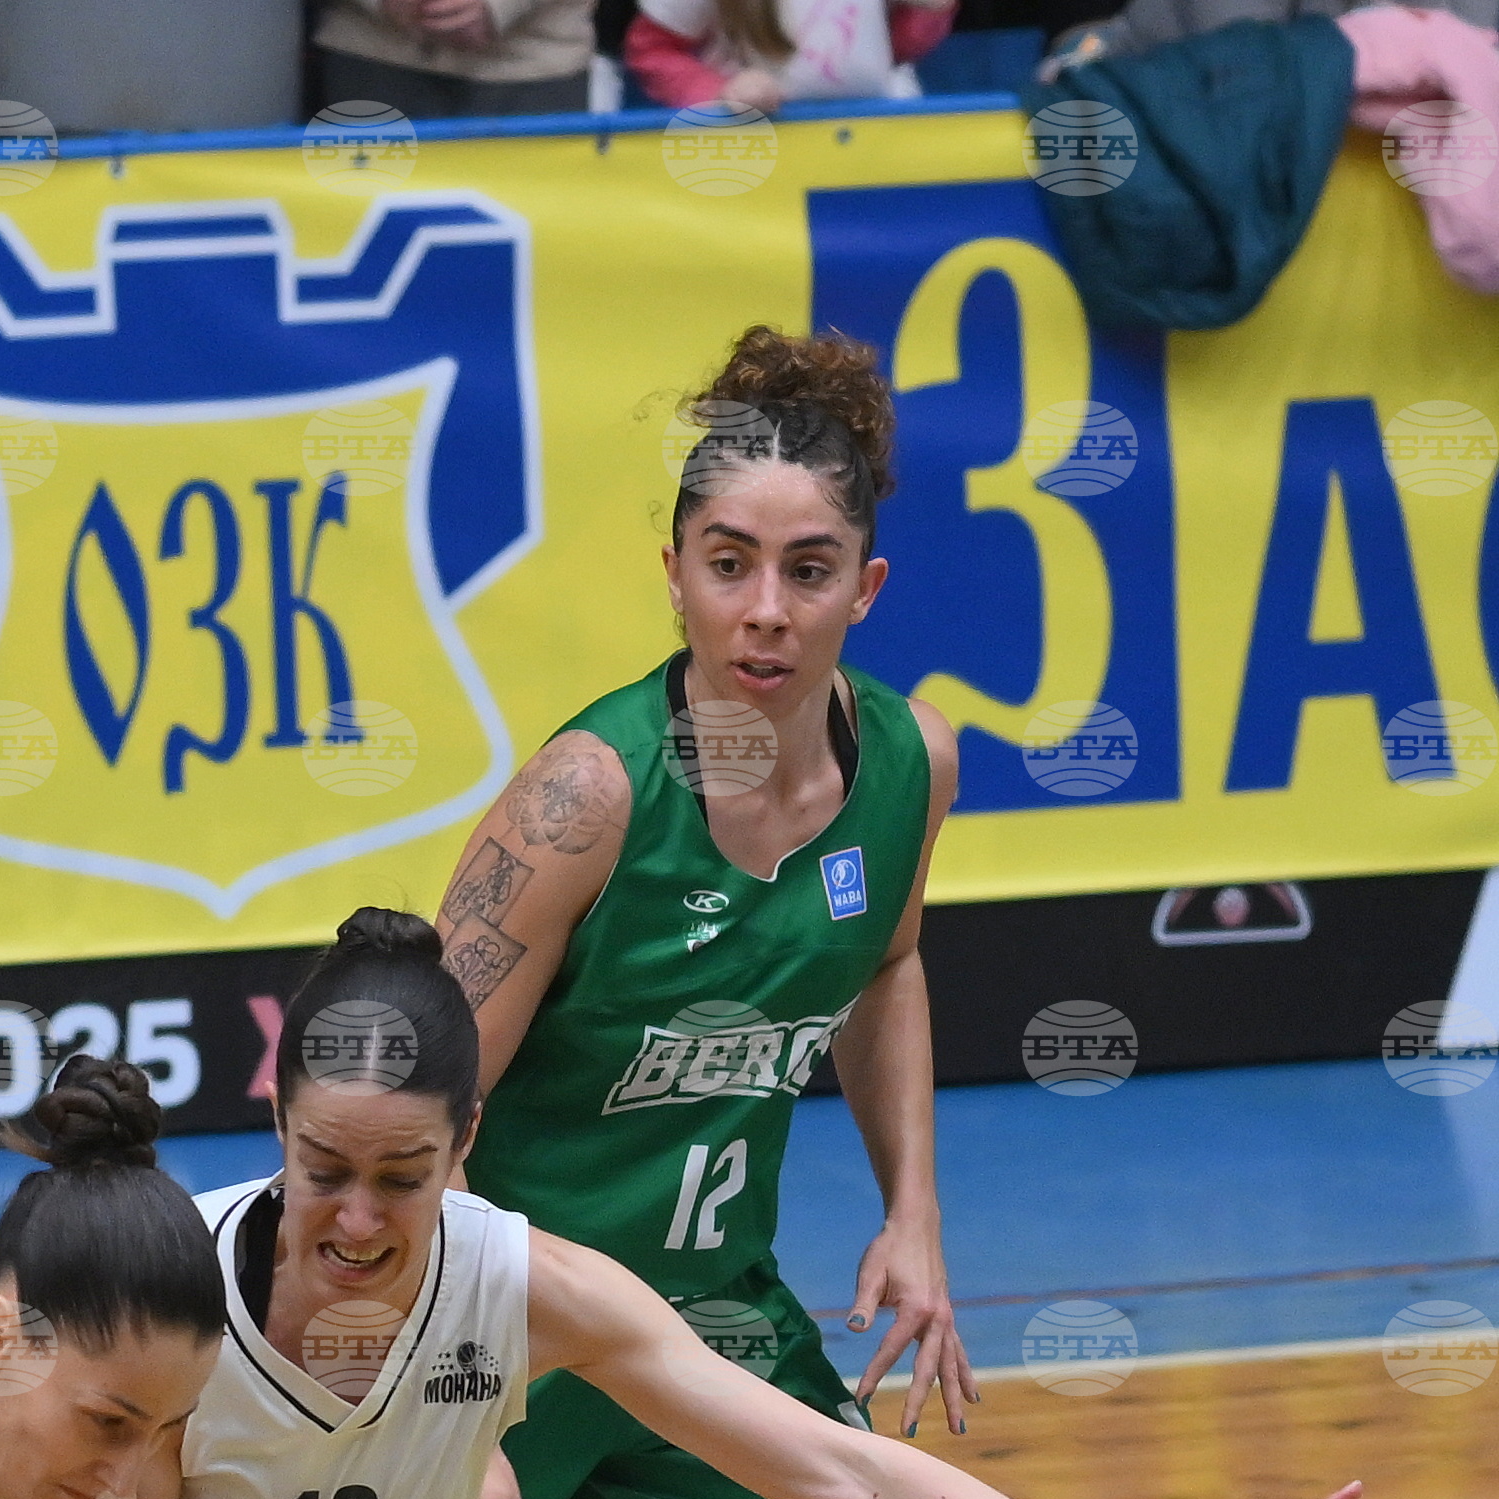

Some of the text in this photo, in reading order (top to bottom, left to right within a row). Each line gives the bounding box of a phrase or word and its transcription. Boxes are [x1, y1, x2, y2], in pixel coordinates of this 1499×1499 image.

[892, 235, 1499, 796] ЗА
[63, 469, 366, 795] ОЗК
[833, 888, 863, 908] WABA
[663, 1137, 748, 1250] 12
